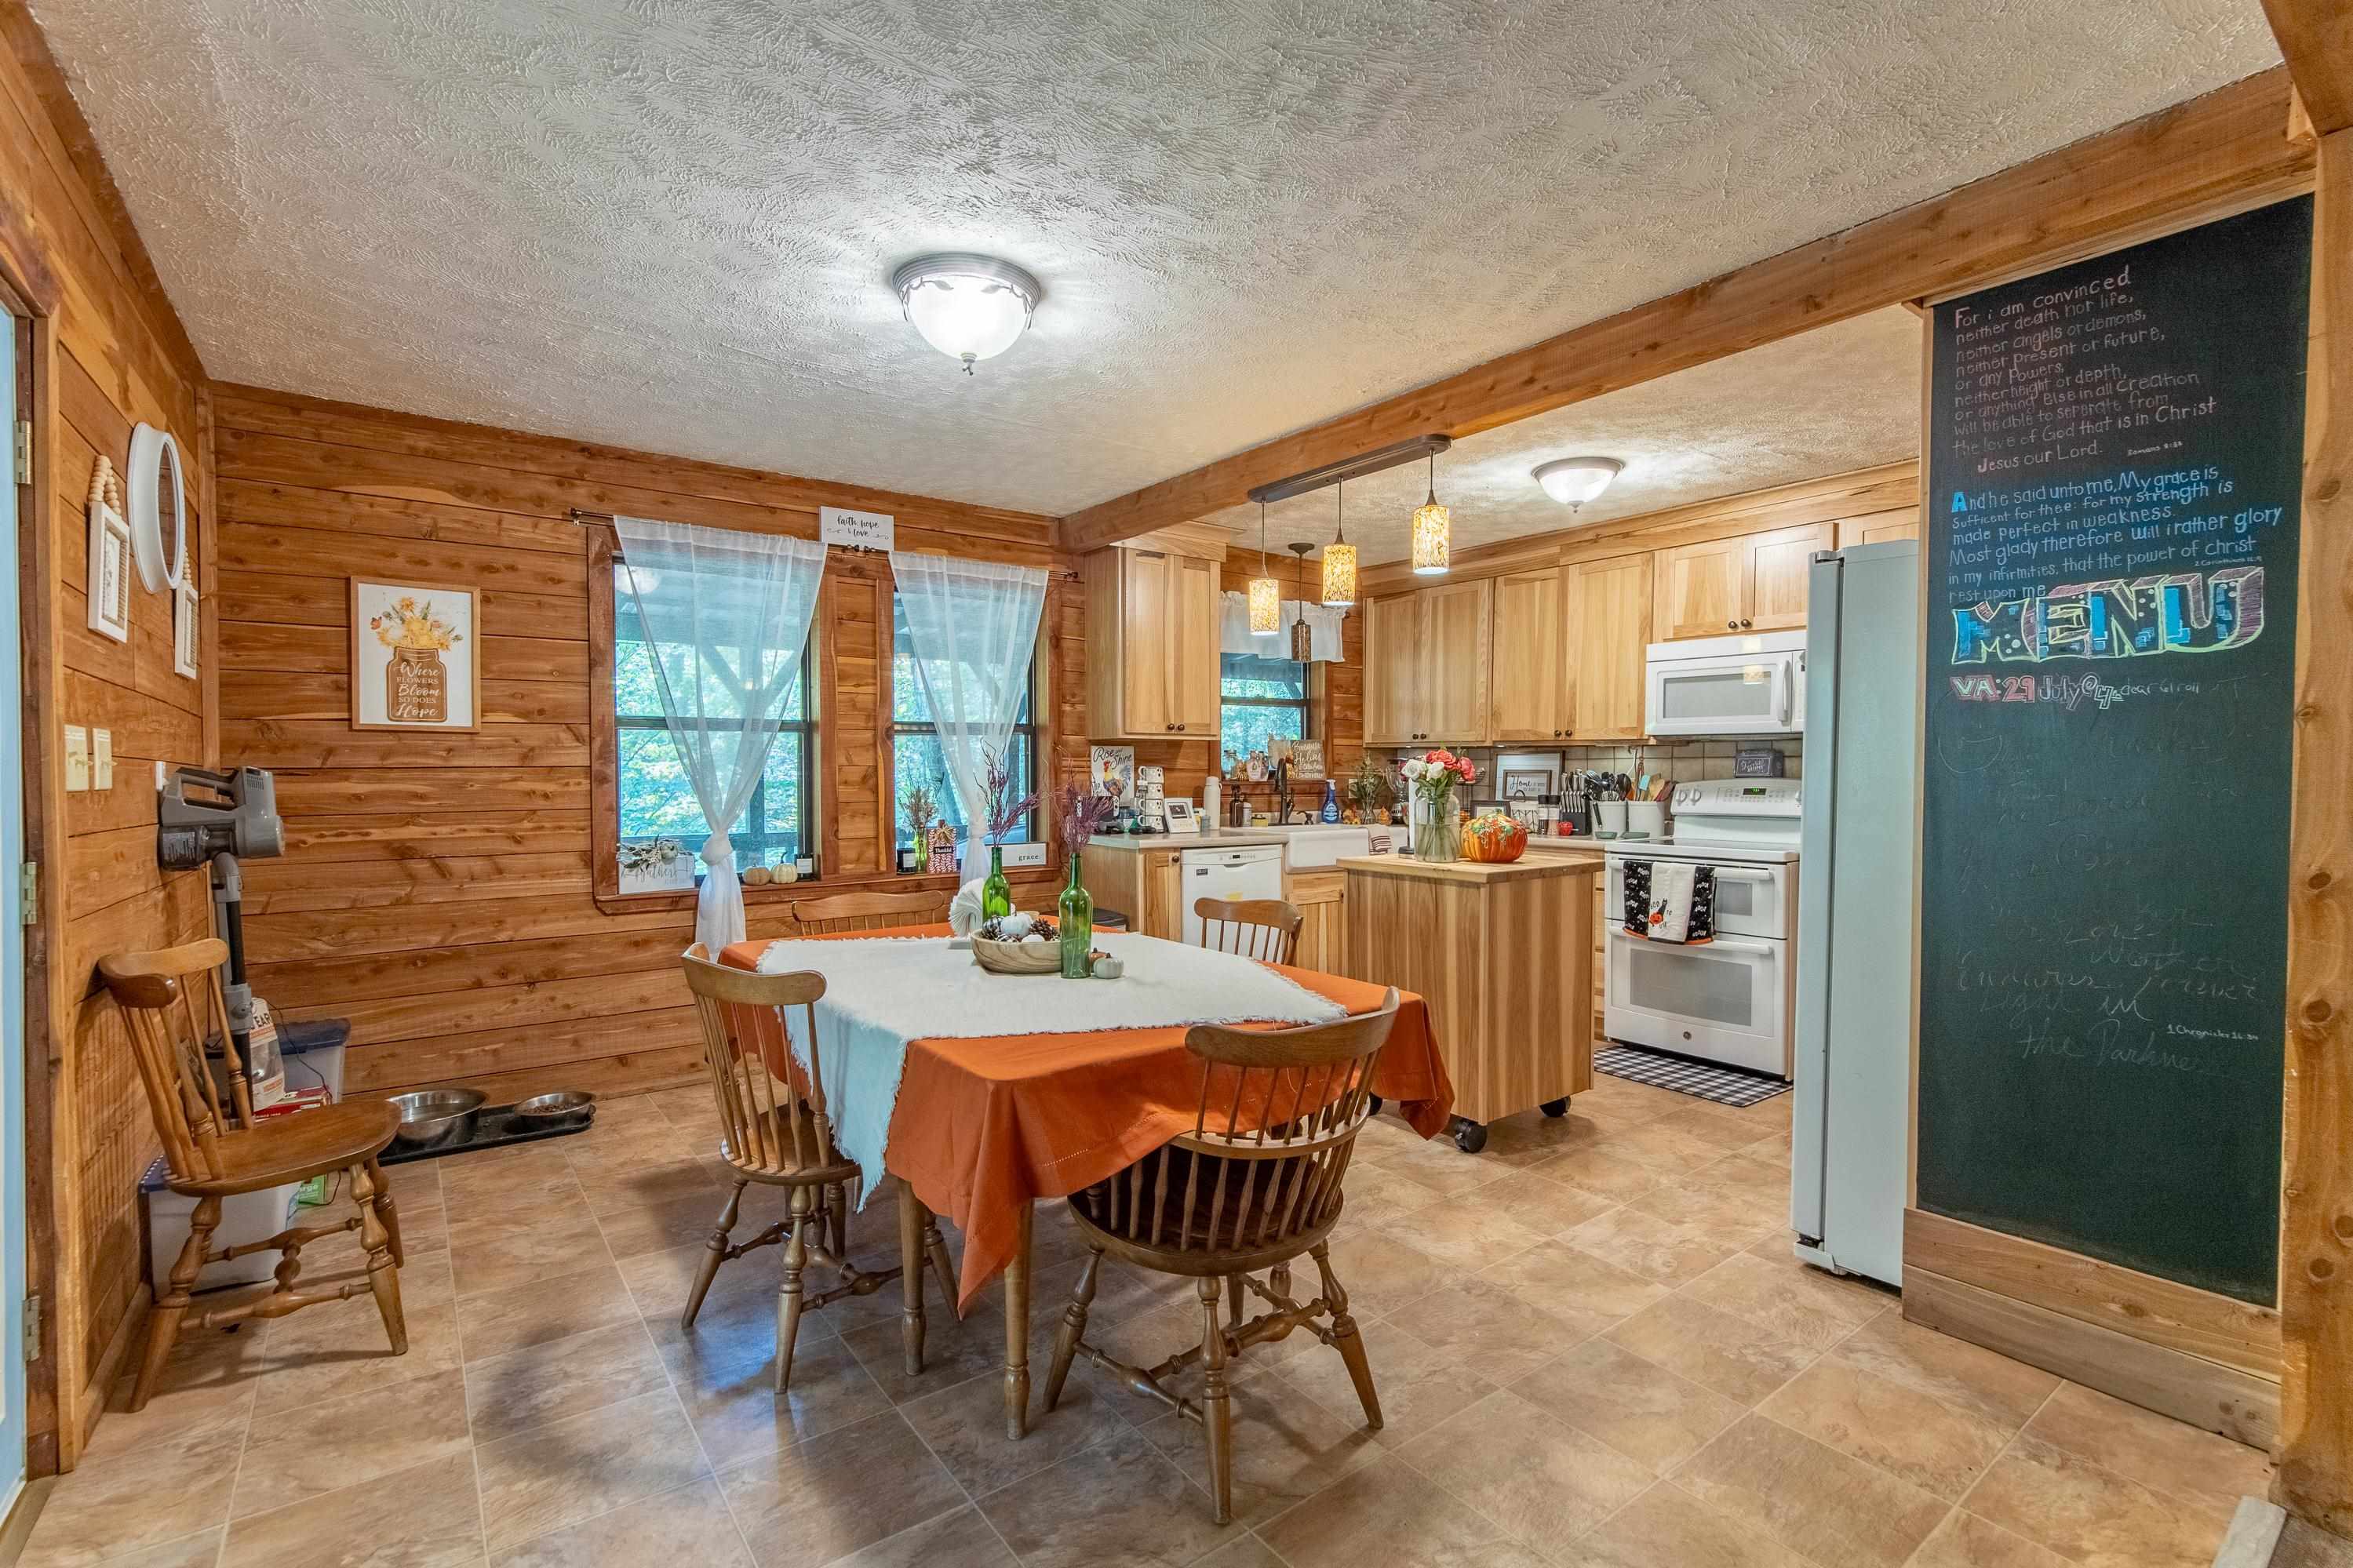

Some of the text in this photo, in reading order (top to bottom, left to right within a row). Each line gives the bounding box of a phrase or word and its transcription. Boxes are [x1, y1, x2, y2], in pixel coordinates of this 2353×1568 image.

[1954, 307, 1980, 329] For
[2000, 303, 2025, 317] am
[2033, 264, 2132, 309] convinced
[1956, 322, 2009, 345] neither
[2014, 307, 2060, 330] death
[2064, 300, 2094, 318] nor
[2013, 326, 2063, 352] angels
[2013, 342, 2076, 370] present
[2082, 340, 2100, 353] or
[2103, 326, 2165, 348] future,
[1954, 380, 1972, 391] or
[1979, 371, 2002, 387] any
[1954, 389, 2009, 408] neither
[2010, 377, 2052, 400] height
[2056, 376, 2072, 387] or
[1954, 410, 1974, 421] or
[1979, 395, 2035, 417] anything
[2079, 388, 2093, 400] in
[2096, 382, 2112, 396] all
[2037, 409, 2054, 423] to
[2127, 390, 2169, 410] from
[1983, 436, 2016, 452] love
[2020, 428, 2038, 445] of
[2042, 421, 2075, 442] God
[2078, 416, 2113, 435] that
[2118, 416, 2132, 430] is
[2135, 413, 2150, 427] in
[2155, 395, 2217, 424] Christ
[1977, 456, 2020, 473] Jesus
[2023, 450, 2053, 465] our
[1951, 490, 1986, 514] And
[1988, 490, 2009, 508] he
[2013, 485, 2047, 504] said
[2049, 481, 2085, 499] unto
[2118, 471, 2151, 493] My
[2153, 469, 2201, 493] grace
[2203, 464, 2219, 480] is
[2014, 507, 2035, 520] for
[2082, 496, 2107, 509] for
[2109, 494, 2133, 508] my
[2136, 481, 2209, 504] strength
[2218, 479, 2235, 494] is
[853, 528, 869, 538] love
[860, 519, 880, 530] hope
[1949, 544, 1992, 566] Most
[2041, 529, 2123, 553] therefore
[2174, 515, 2229, 535] rather
[2234, 507, 2282, 533] glory
[1953, 529, 1991, 546] made
[1998, 517, 2060, 542] perfect
[2066, 520, 2078, 531] in
[1948, 572, 1959, 584] in
[1964, 572, 1982, 587] my
[2062, 553, 2096, 573] that
[2096, 551, 2122, 569] the
[2127, 546, 2176, 573] power
[2180, 539, 2200, 558] of
[1949, 584, 2047, 603] rest upon me
[1951, 566, 2265, 665] MENU
[394, 661, 440, 678] Where
[396, 676, 439, 685] FLOWERS
[398, 683, 440, 697] Bloom
[413, 696, 437, 704] DOES
[395, 703, 439, 719] Hope
[1093, 746, 1115, 762] Rise
[1109, 752, 1132, 770] Shine
